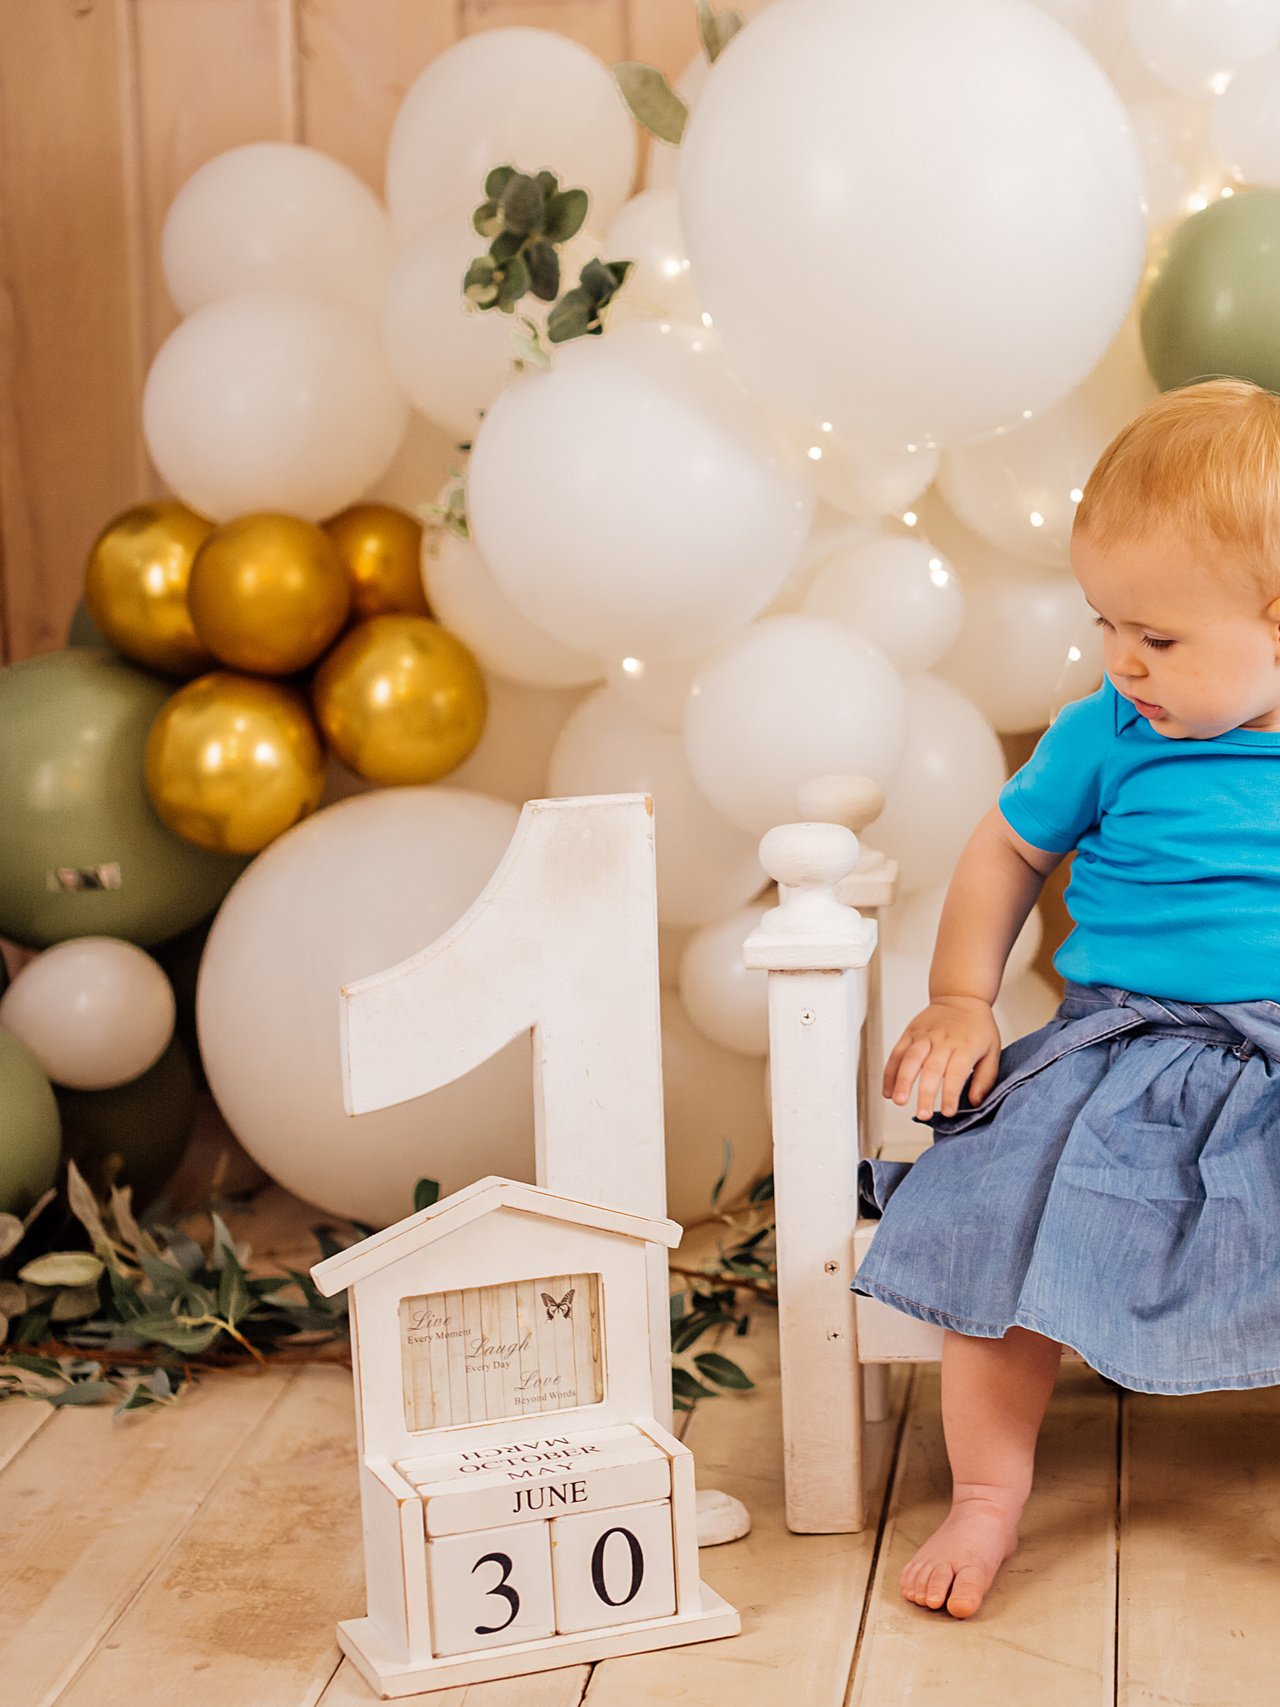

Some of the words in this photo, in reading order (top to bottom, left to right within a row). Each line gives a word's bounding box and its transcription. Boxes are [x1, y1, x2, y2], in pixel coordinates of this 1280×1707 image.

[407, 1310, 451, 1331] Live
[407, 1334, 433, 1345] Every
[436, 1329, 472, 1340] Moment
[465, 1329, 533, 1360] Laugh
[465, 1363, 490, 1373] Every
[493, 1360, 511, 1370] Day
[513, 1369, 562, 1391] Love
[514, 1393, 547, 1405] Beyond
[549, 1389, 577, 1400] Words
[459, 1445, 602, 1474] OCTOBER
[461, 1437, 571, 1461] MARCH
[507, 1462, 574, 1480] MAY
[512, 1480, 589, 1514] JUNE
